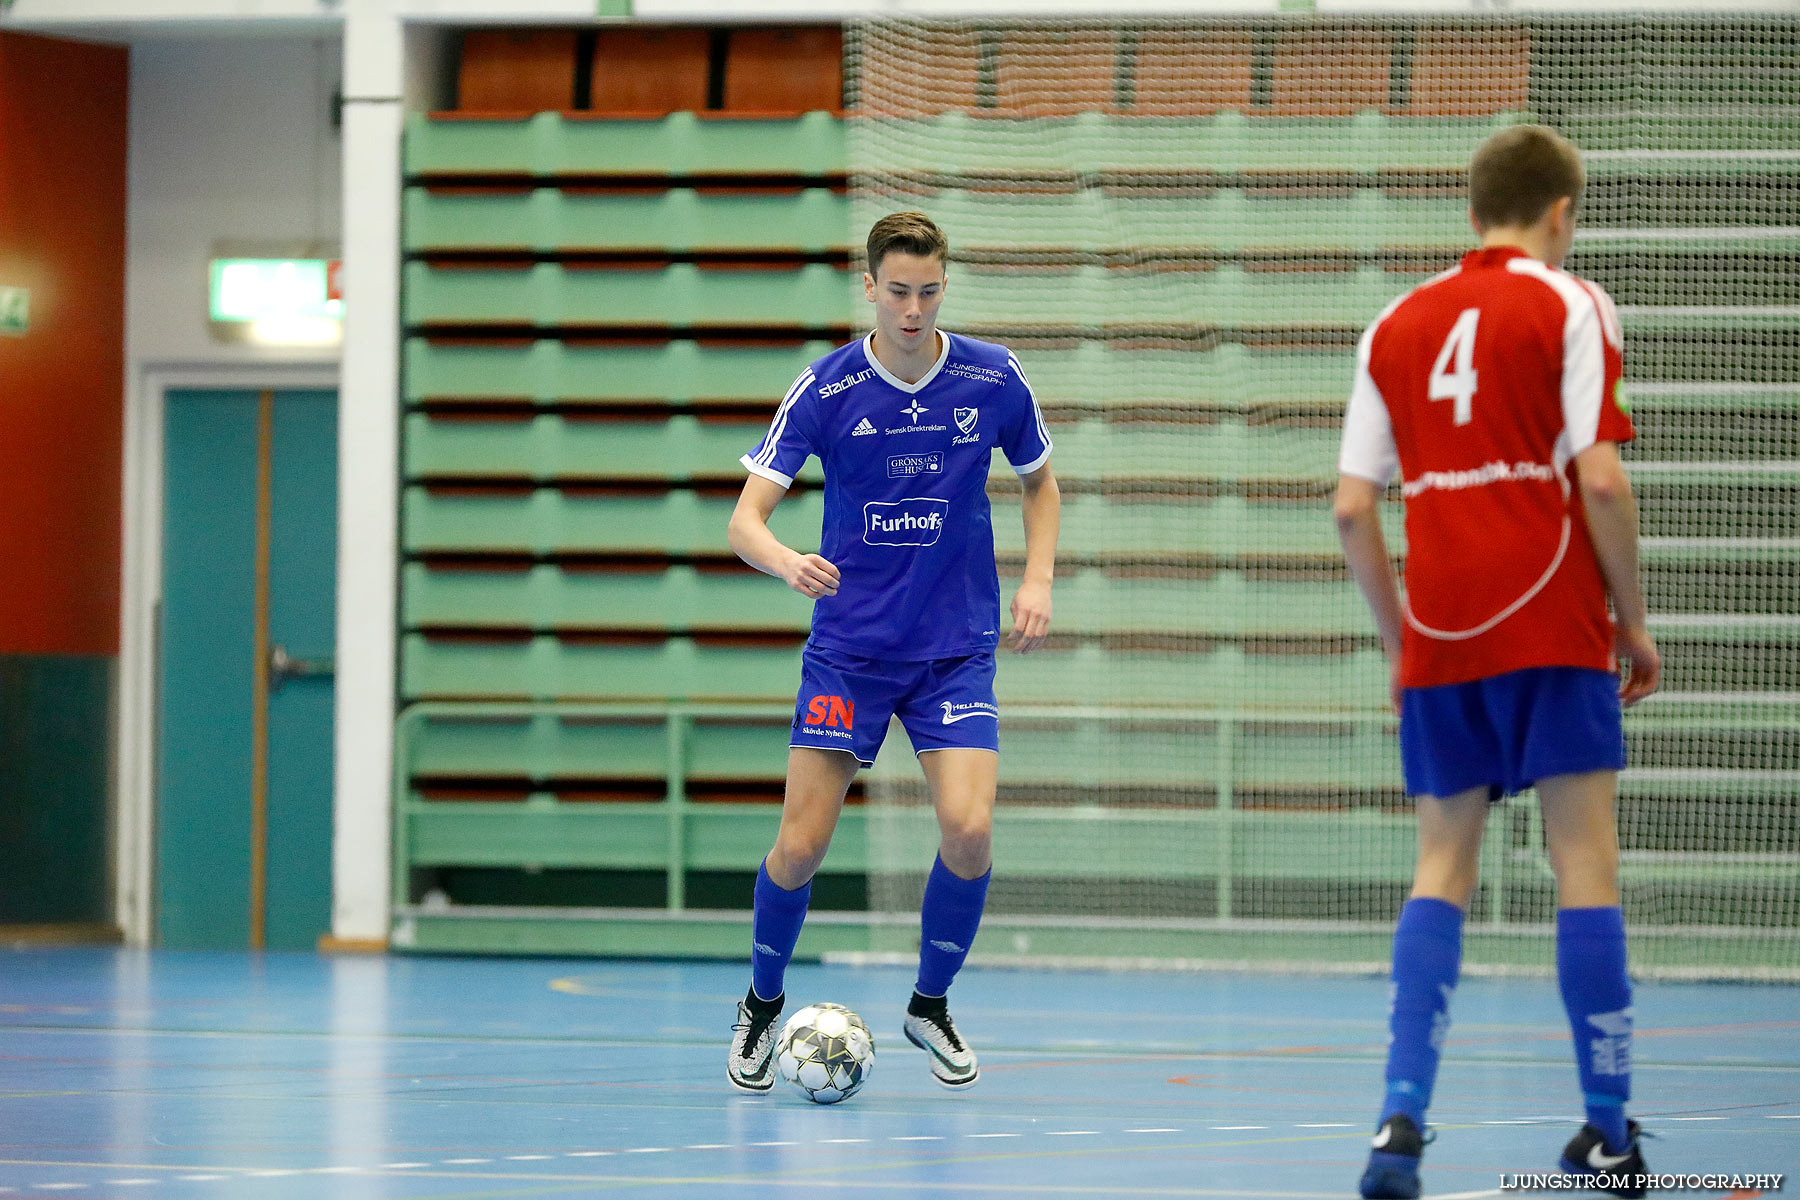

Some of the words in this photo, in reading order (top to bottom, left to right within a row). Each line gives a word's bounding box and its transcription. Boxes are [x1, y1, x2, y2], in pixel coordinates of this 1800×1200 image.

[1428, 307, 1480, 426] 4
[818, 367, 876, 399] stadium
[852, 428, 878, 437] adidas
[885, 427, 907, 436] Svensk
[907, 424, 947, 432] Direktreklam
[952, 433, 980, 446] Fotboll
[871, 512, 943, 531] Furhoffs
[805, 695, 855, 730] SN
